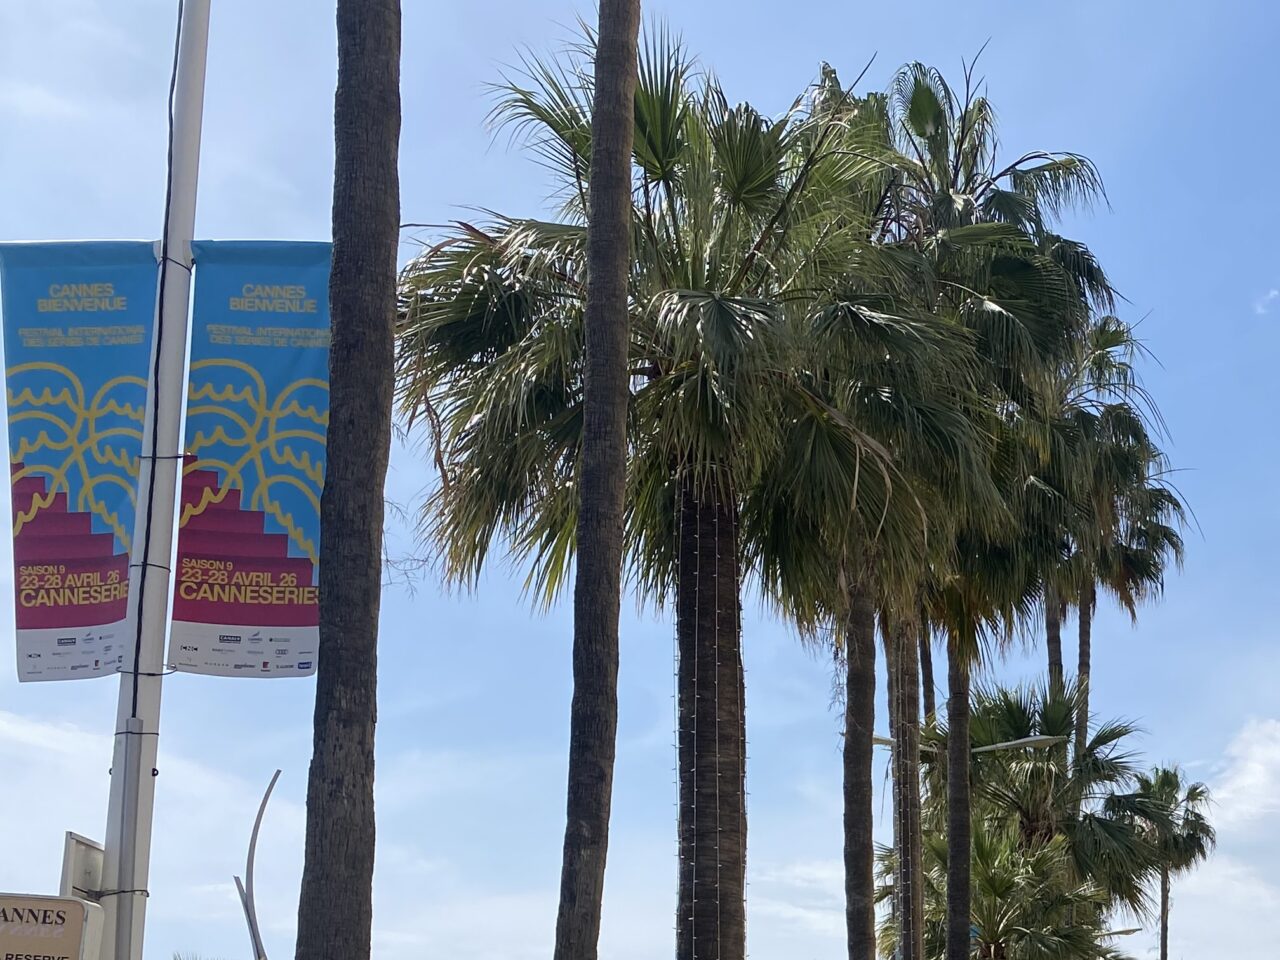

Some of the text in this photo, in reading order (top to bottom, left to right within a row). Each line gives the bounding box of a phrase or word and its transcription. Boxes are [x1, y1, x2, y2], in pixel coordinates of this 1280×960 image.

[49, 283, 114, 298] CANNES
[242, 284, 306, 299] CANNES
[37, 296, 128, 312] BIENVENUE
[229, 297, 318, 313] BIENVENUE
[19, 565, 66, 575] SAISON 9
[182, 558, 234, 571] SAISON 9
[20, 570, 121, 590] 23-28 AVRIL 26
[181, 567, 297, 587] 23-28 AVRIL 26
